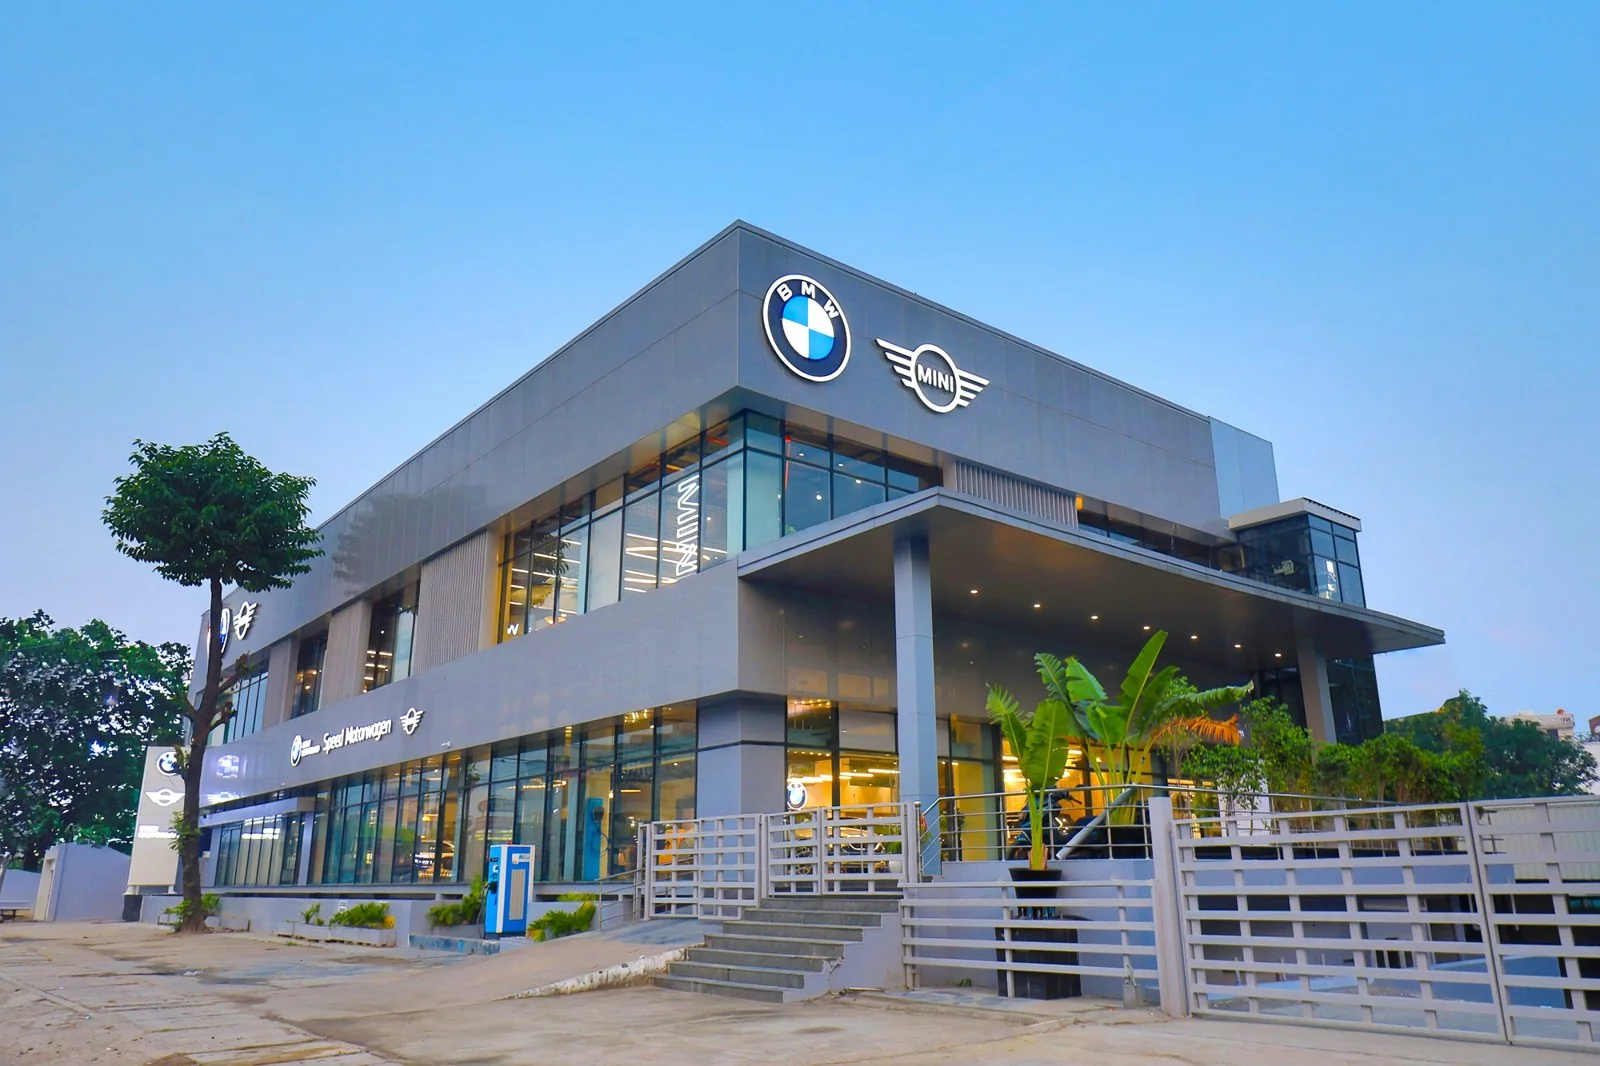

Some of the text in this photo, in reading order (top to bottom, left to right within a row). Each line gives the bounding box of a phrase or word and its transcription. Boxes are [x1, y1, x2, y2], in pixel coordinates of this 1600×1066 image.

[777, 281, 840, 319] BMW
[917, 363, 954, 393] MINI
[322, 728, 345, 755] Speed
[345, 719, 392, 746] Motorwagen
